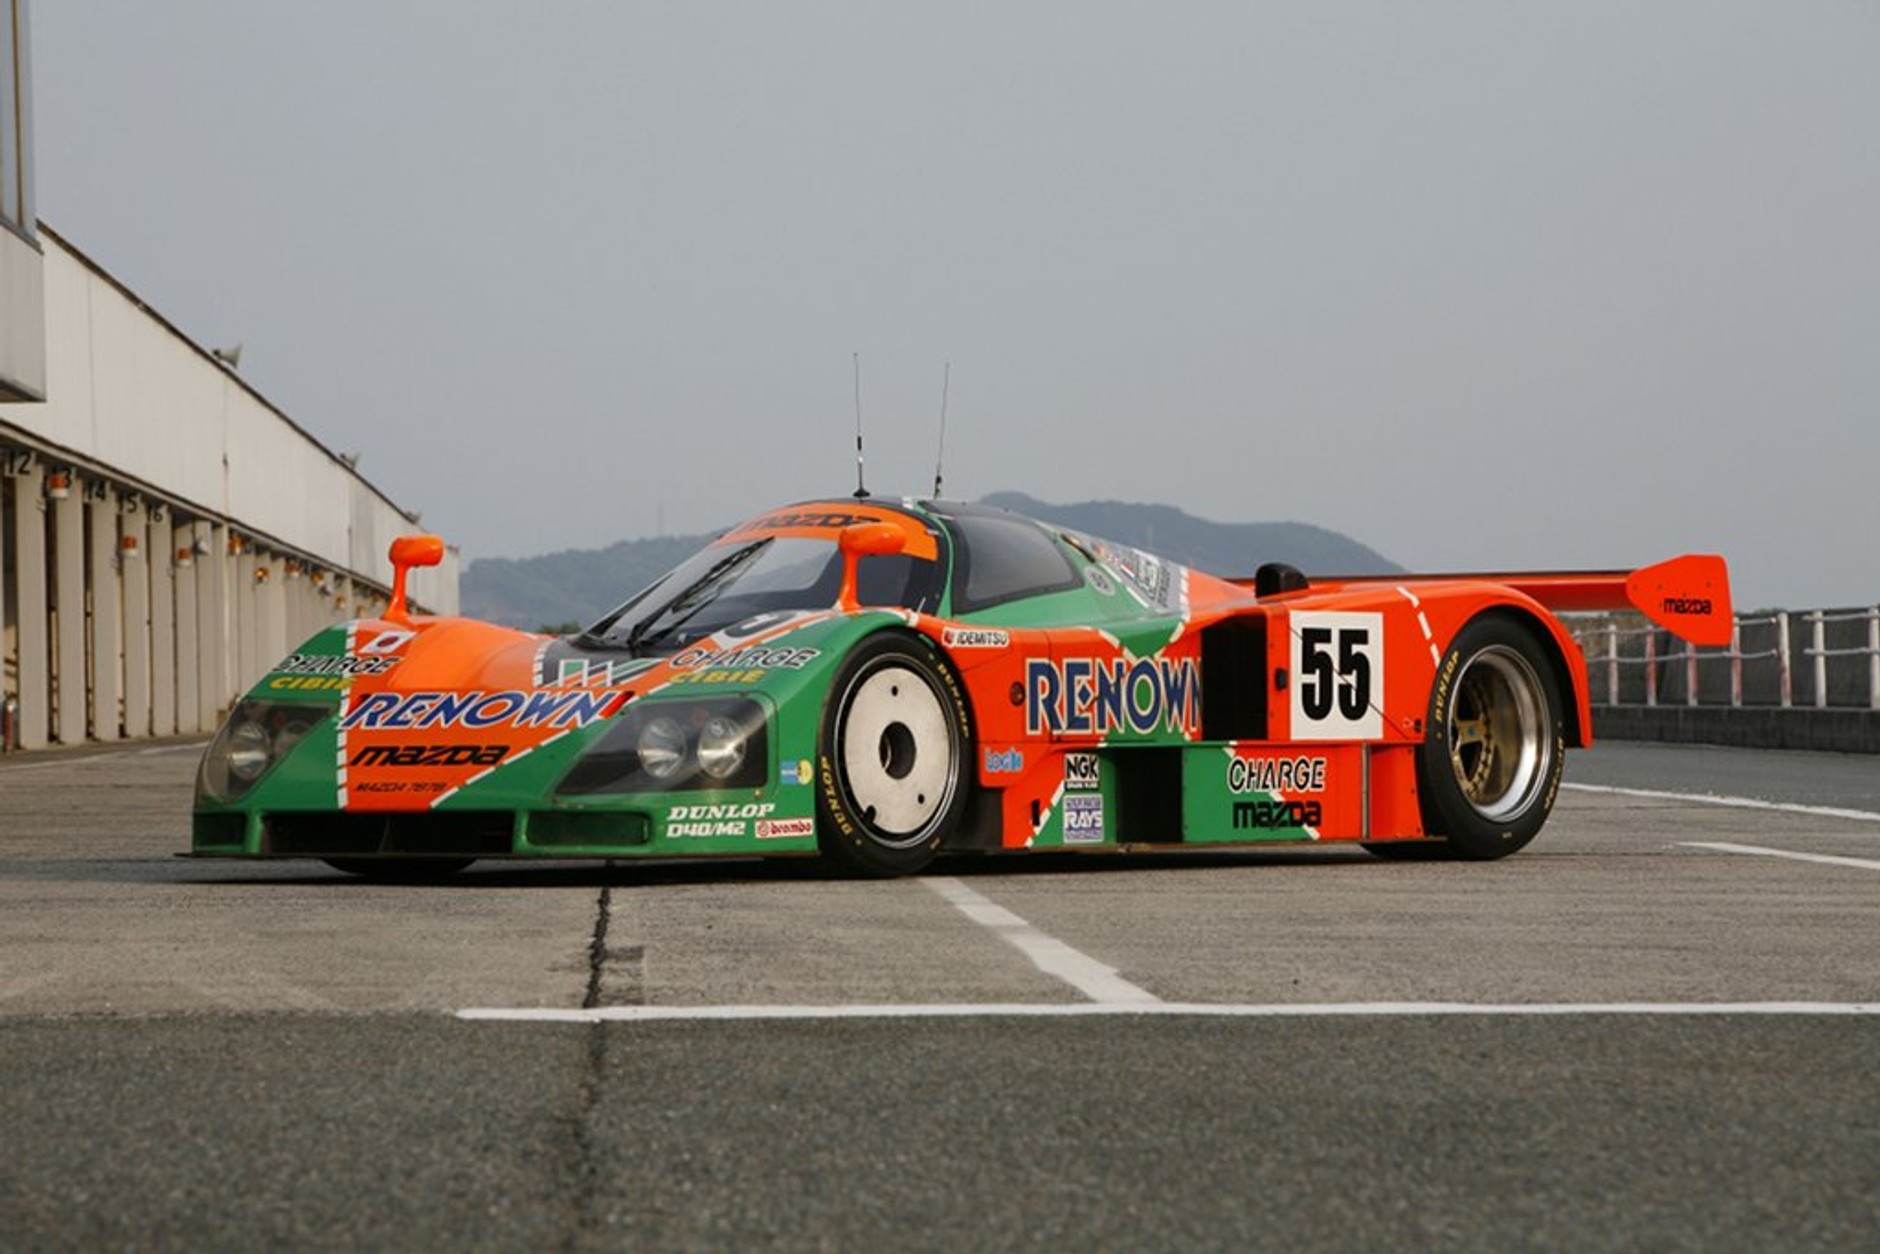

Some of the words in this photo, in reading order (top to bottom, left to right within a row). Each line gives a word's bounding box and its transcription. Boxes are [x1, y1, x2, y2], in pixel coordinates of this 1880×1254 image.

[8, 451, 31, 475] 12
[87, 480, 106, 501] 14
[118, 493, 138, 513] 15
[1663, 598, 1712, 615] mazda
[956, 631, 1008, 646] IDEMITSU
[670, 647, 820, 669] CHARGE
[1301, 627, 1371, 721] 55
[338, 689, 620, 731] RENOWN
[350, 745, 511, 767] mazda
[1065, 755, 1099, 780] NGK
[1228, 757, 1326, 793] CHARGE
[667, 803, 776, 821] DUNLOP
[1064, 809, 1102, 829] RAYS
[1233, 801, 1323, 829] mazda
